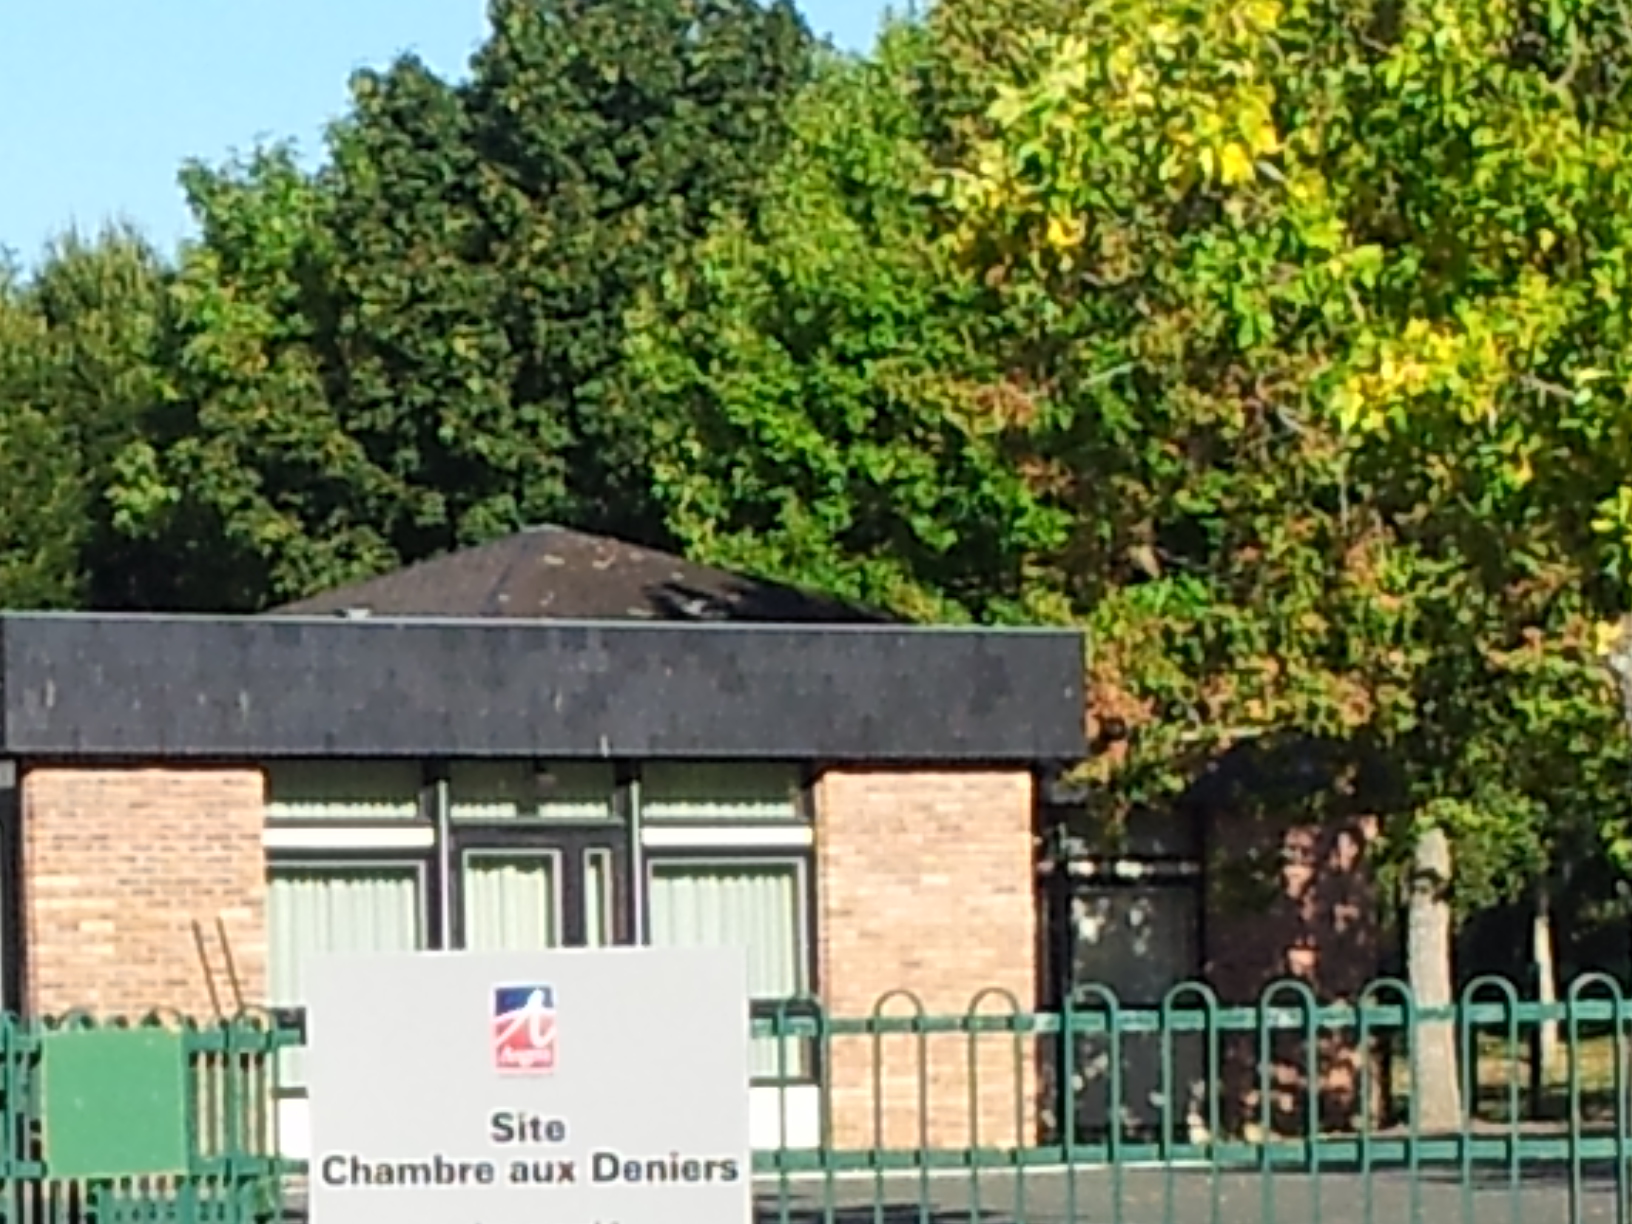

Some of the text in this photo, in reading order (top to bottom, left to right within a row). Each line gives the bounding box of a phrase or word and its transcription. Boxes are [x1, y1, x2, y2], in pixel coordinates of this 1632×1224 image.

[491, 1112, 566, 1142] Site
[322, 1152, 739, 1186] Chambre aux Deniers
